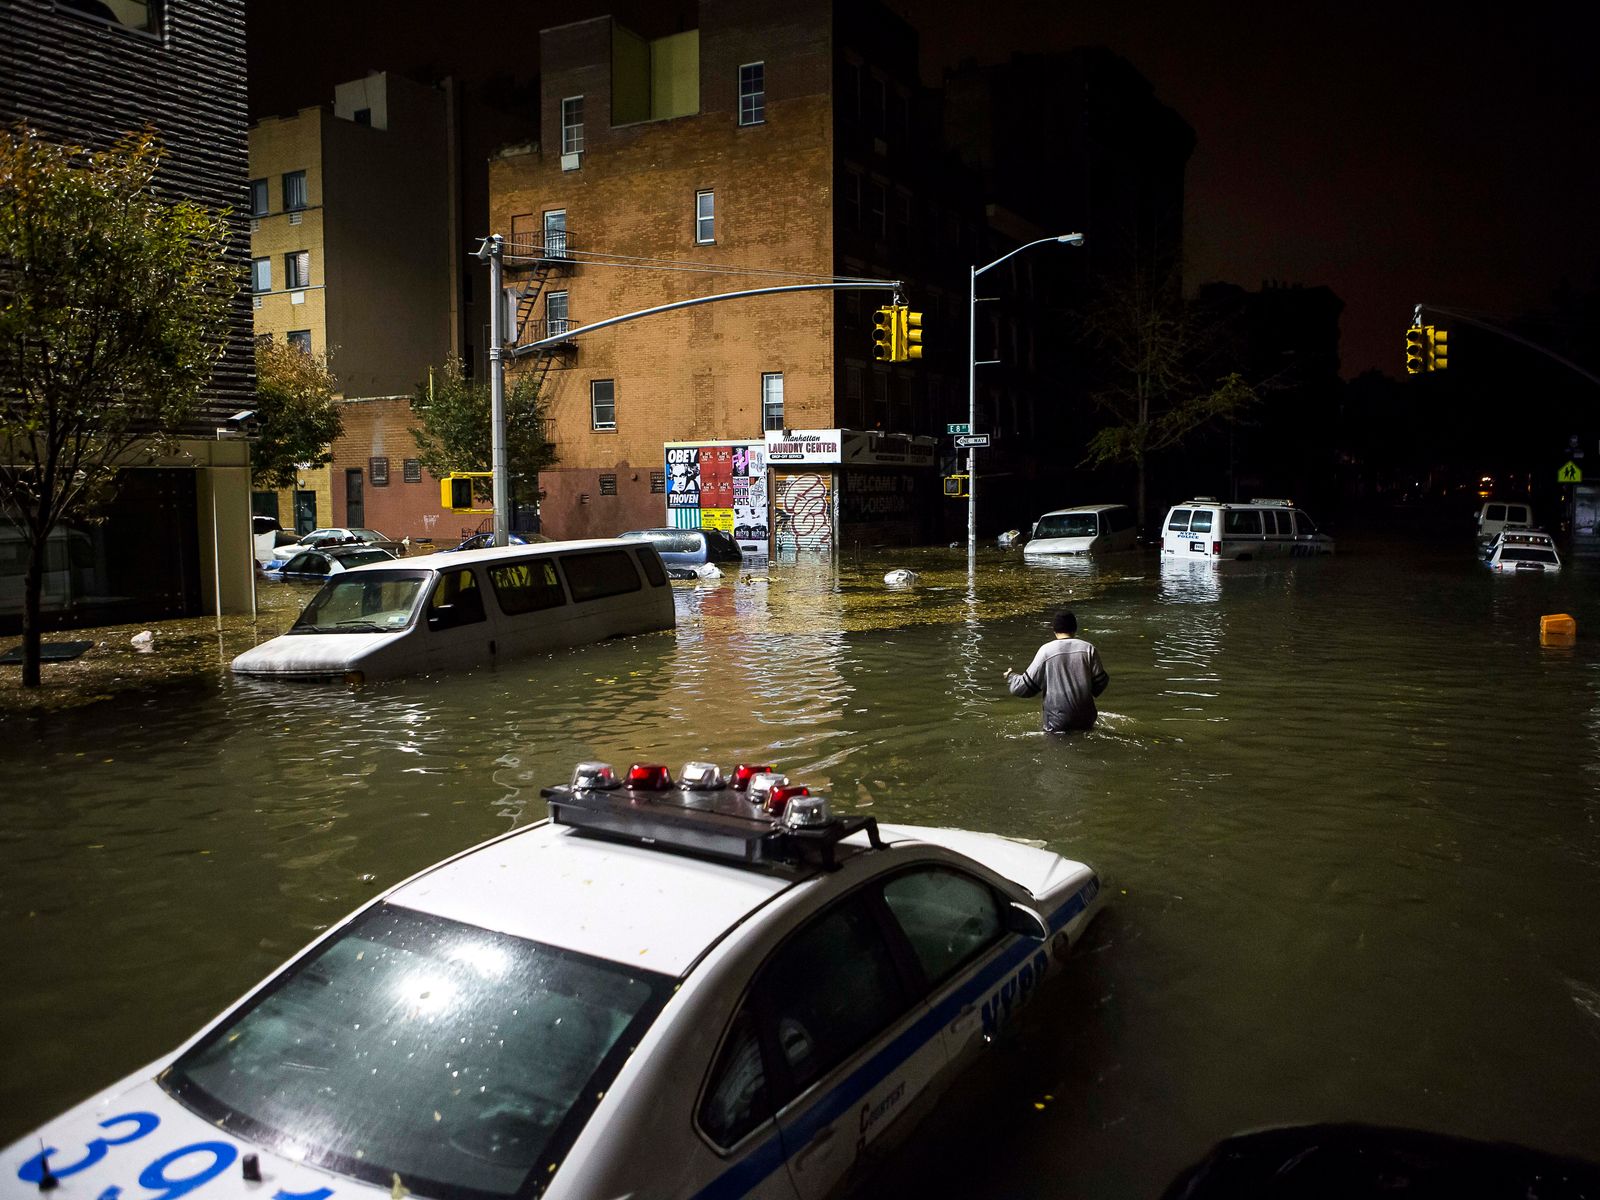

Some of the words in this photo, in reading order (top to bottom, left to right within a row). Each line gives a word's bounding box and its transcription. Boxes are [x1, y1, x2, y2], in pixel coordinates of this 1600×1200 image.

[955, 425, 961, 433] 8
[783, 434, 821, 442] Manhattan
[768, 443, 804, 453] LAUNDRY
[806, 442, 837, 453] CENTER
[668, 449, 698, 463] OBEY
[669, 493, 699, 503] THOVEN
